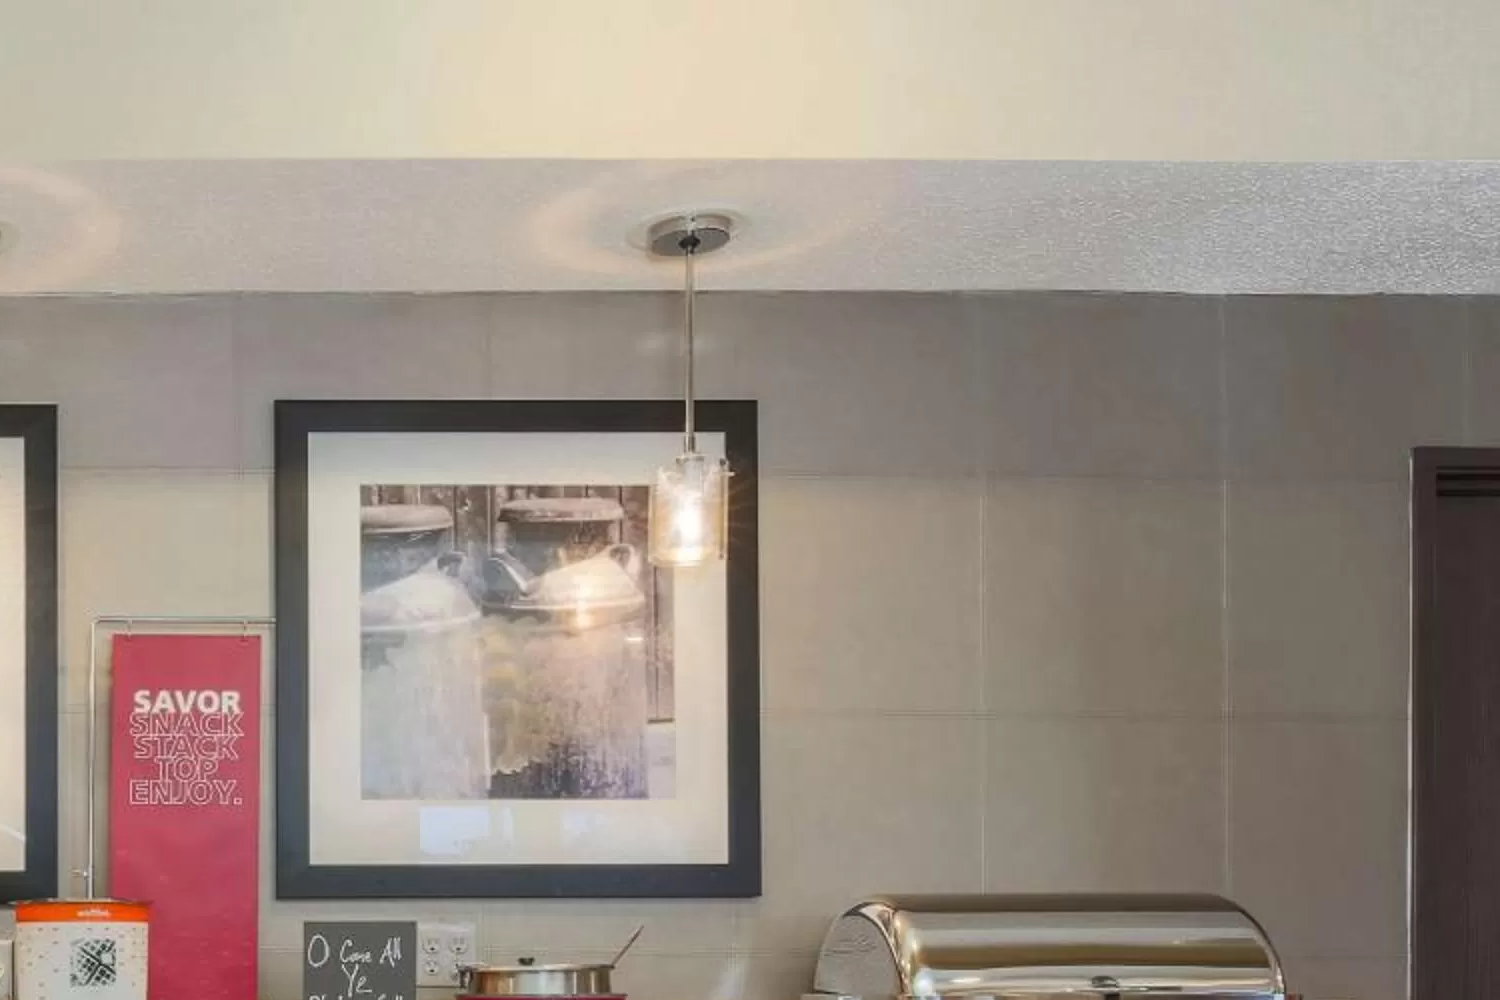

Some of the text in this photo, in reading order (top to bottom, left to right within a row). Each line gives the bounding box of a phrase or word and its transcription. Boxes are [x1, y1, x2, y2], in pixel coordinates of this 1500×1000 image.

[133, 690, 240, 713] SAVOR
[130, 712, 244, 736] SNACK
[133, 735, 239, 759] STACK
[154, 757, 219, 781] TOP
[129, 779, 243, 805] ENJOY.
[307, 933, 330, 968] O
[341, 963, 372, 997] Ye
